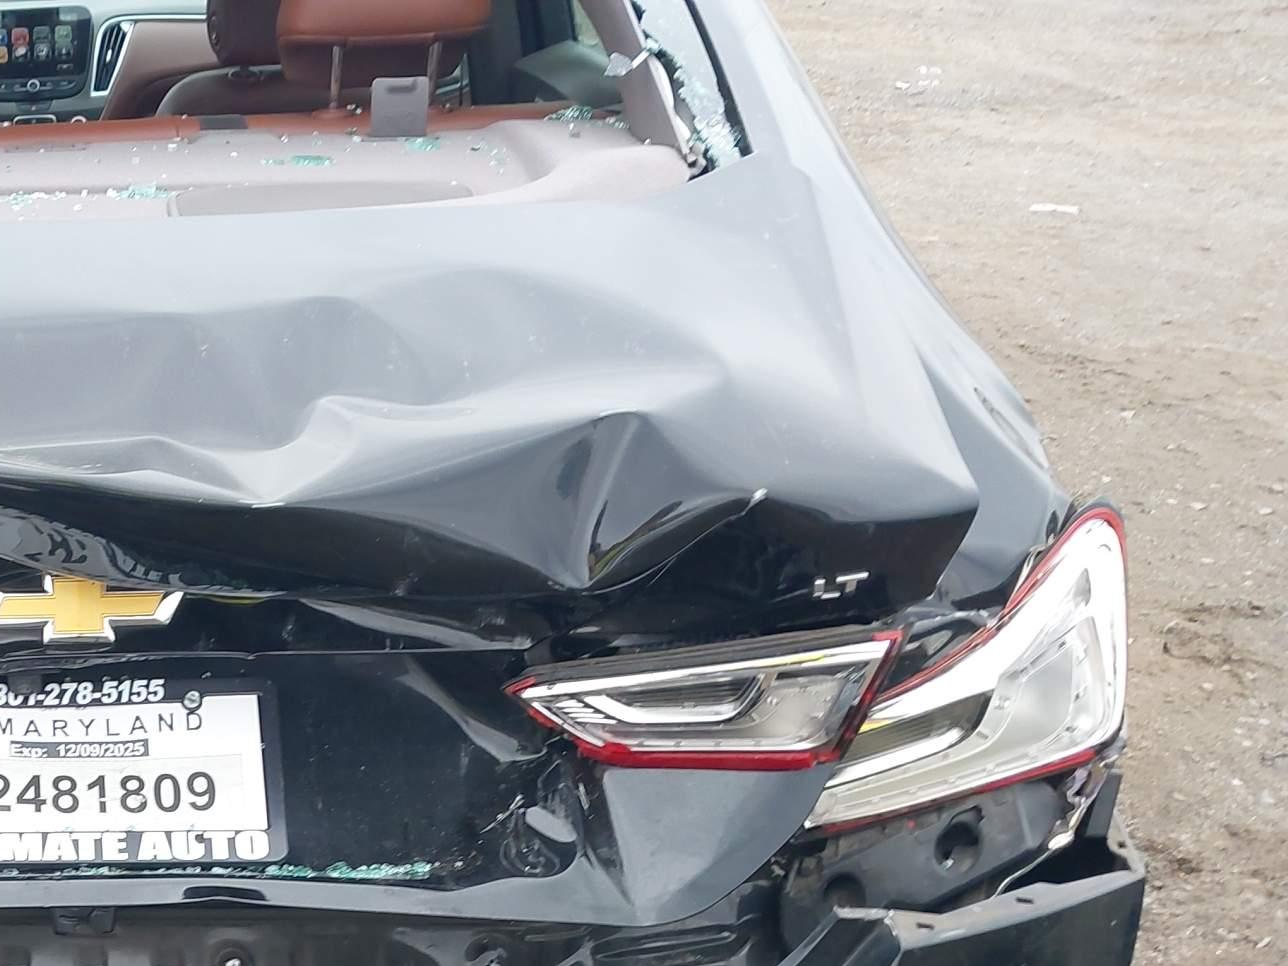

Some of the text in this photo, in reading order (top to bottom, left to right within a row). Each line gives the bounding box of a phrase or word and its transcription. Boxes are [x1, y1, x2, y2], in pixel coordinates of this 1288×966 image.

[813, 571, 869, 599] LT
[55, 742, 145, 758] 12/09/2025
[136, 830, 269, 861] AUTO
